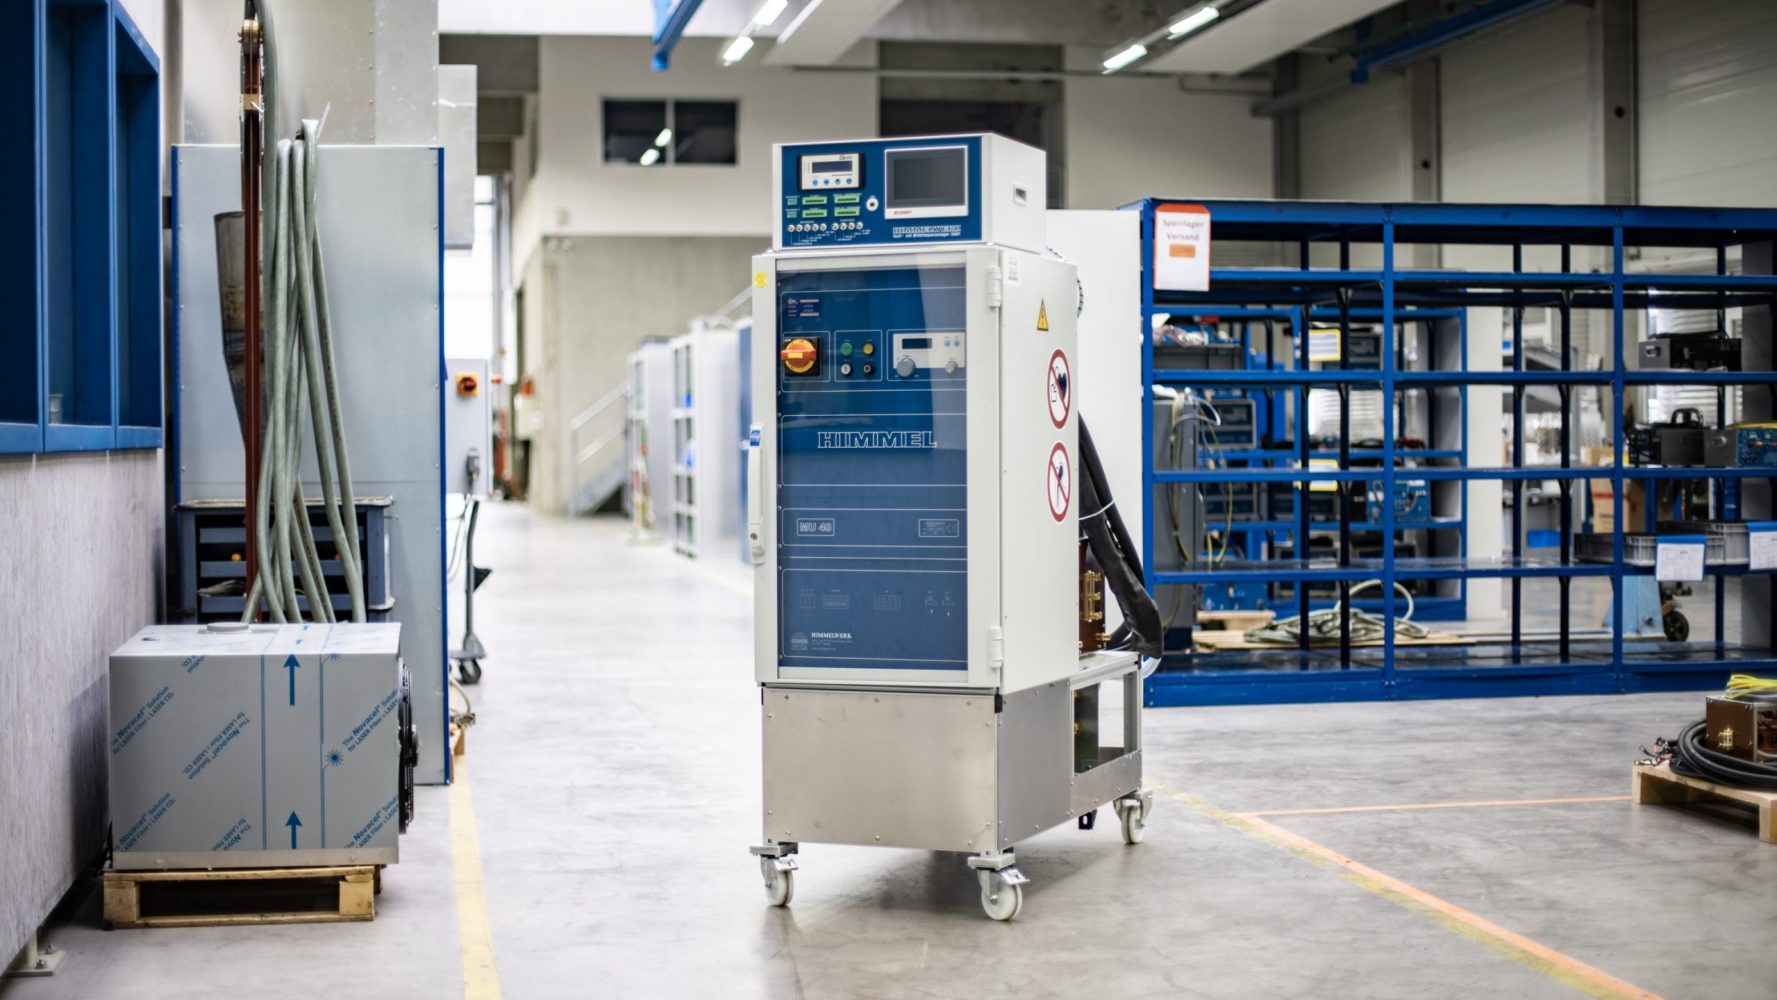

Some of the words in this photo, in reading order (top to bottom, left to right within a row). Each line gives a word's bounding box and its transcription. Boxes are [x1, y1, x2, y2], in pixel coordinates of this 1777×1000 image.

[1167, 232, 1200, 241] Versand
[817, 431, 937, 448] HIMMEL
[800, 522, 817, 532] MU
[119, 731, 135, 748] LASER
[150, 700, 166, 717] LASER
[221, 719, 237, 736] LASER
[354, 728, 371, 745] LASER
[192, 749, 208, 766] LASER
[151, 806, 167, 823] LASER
[223, 825, 239, 842] LASER
